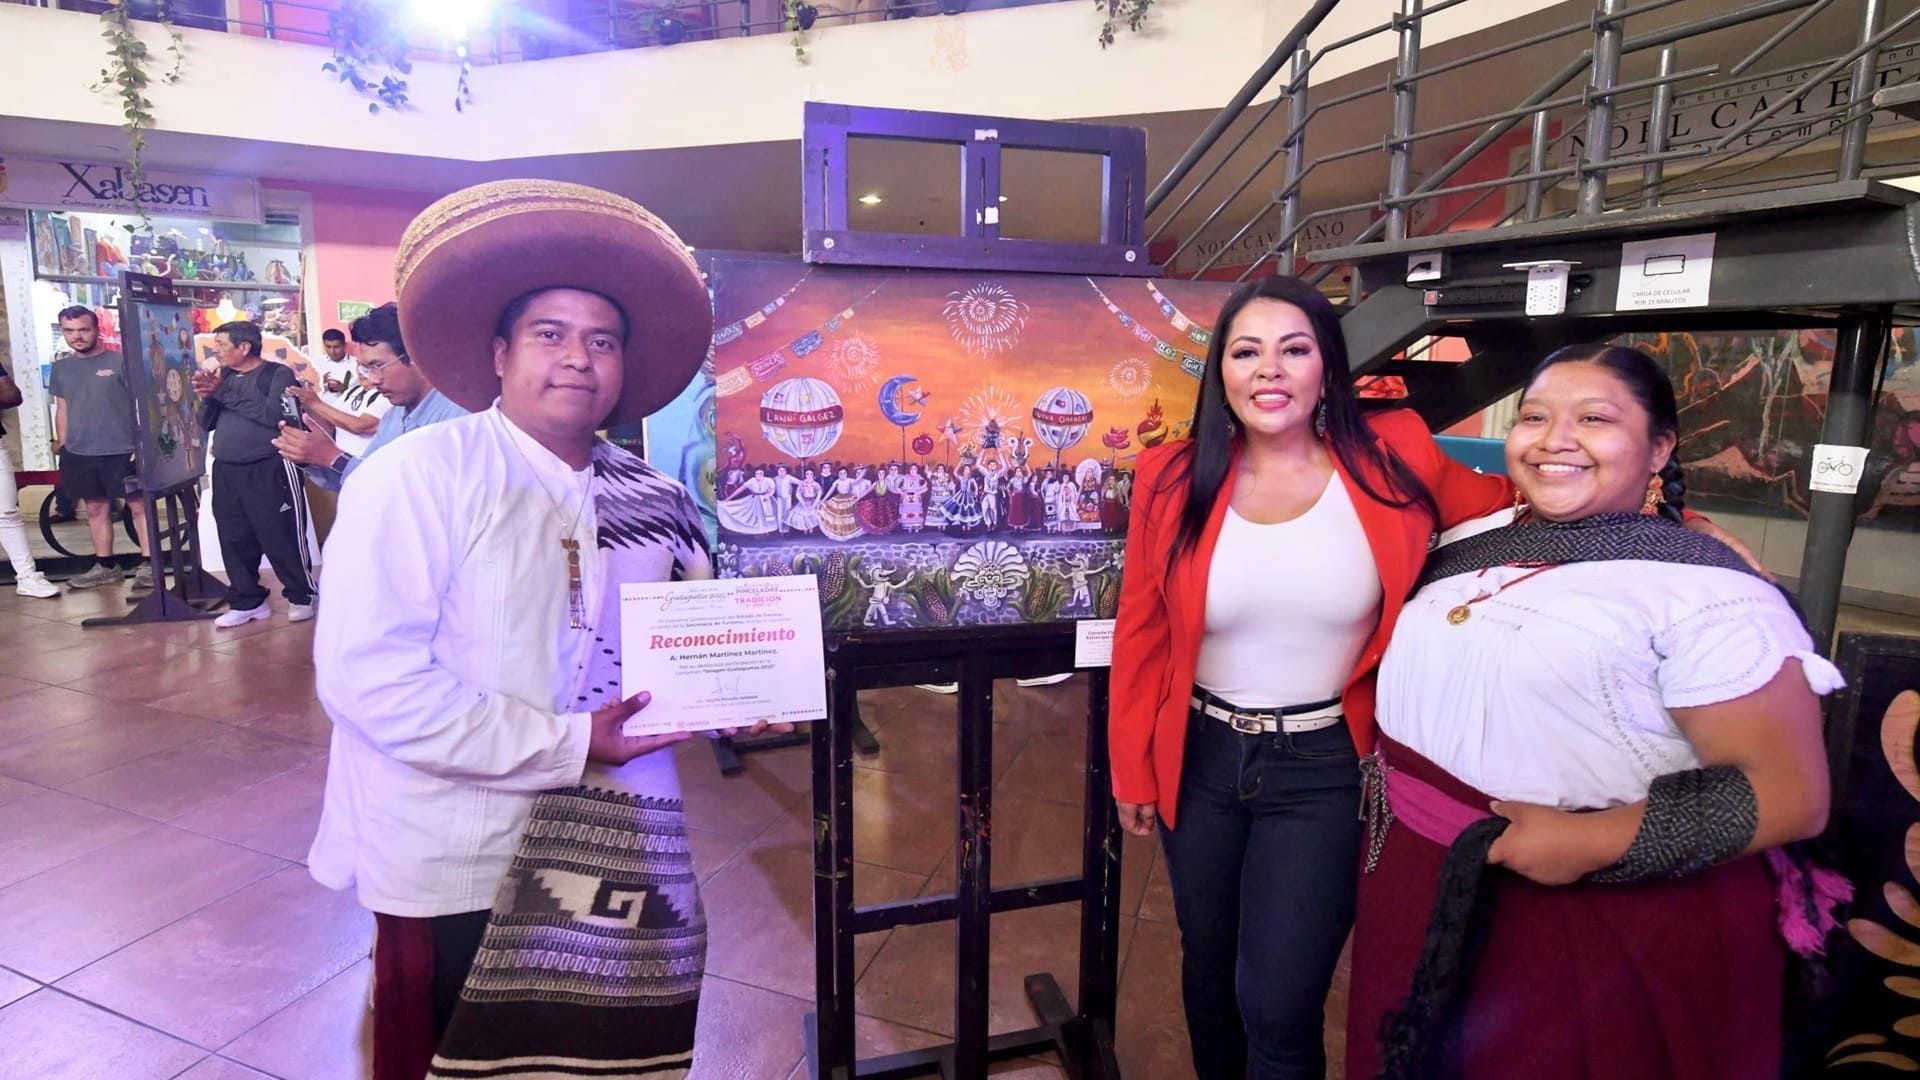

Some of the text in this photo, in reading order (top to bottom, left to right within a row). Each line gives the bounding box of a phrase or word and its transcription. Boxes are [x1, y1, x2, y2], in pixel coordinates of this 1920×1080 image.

[1786, 72, 1809, 83] de
[1711, 68, 1920, 129] CAYET
[57, 161, 211, 208] Xabasen
[1243, 221, 1344, 250] CAYANO
[1663, 288, 1691, 296] CELULAR
[1656, 297, 1687, 305] MINUTOS
[649, 627, 796, 649] Reconocimiento
[680, 652, 708, 660] Hernán
